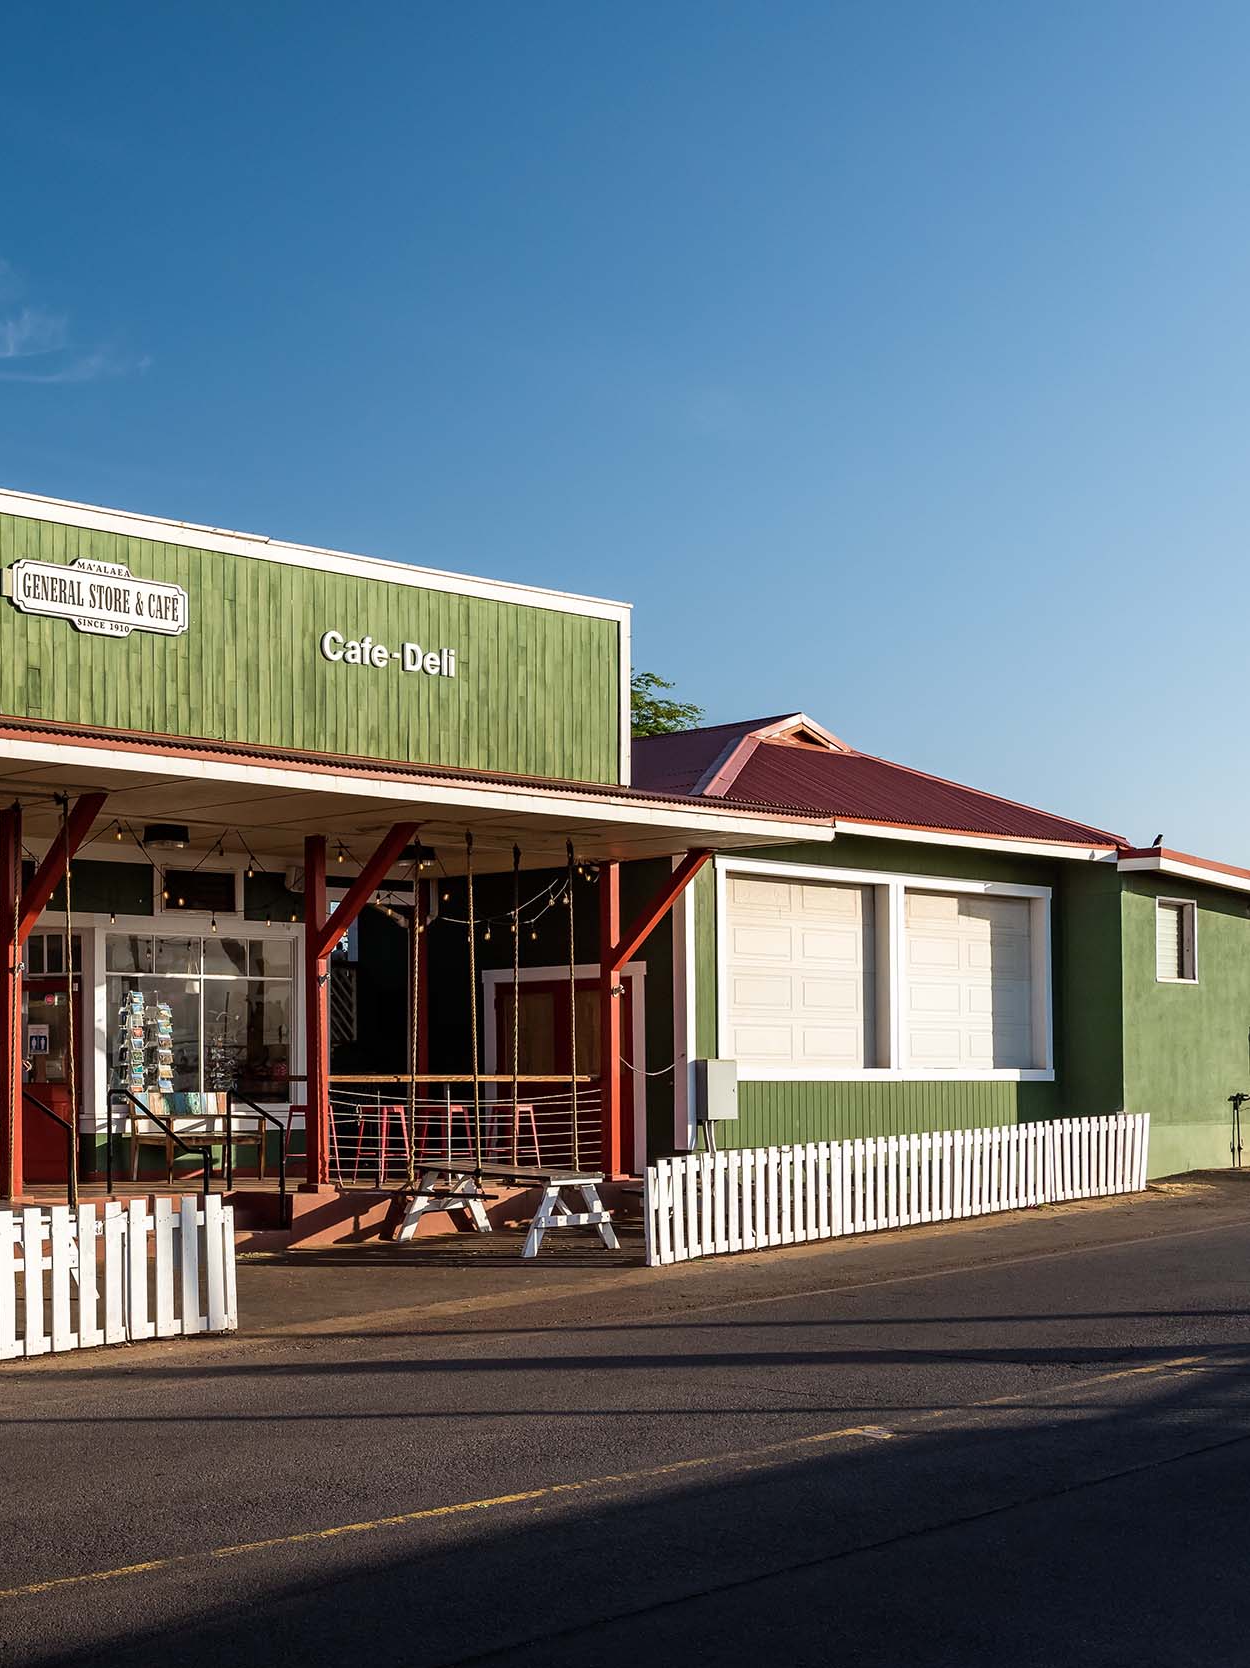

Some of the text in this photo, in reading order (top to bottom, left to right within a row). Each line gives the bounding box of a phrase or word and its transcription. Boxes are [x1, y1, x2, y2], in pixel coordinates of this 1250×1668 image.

[23, 572, 179, 622] GENERAL STORE & CAFÉ
[77, 618, 130, 633] SINCE 1910
[321, 630, 456, 678] Cafe-Deli
